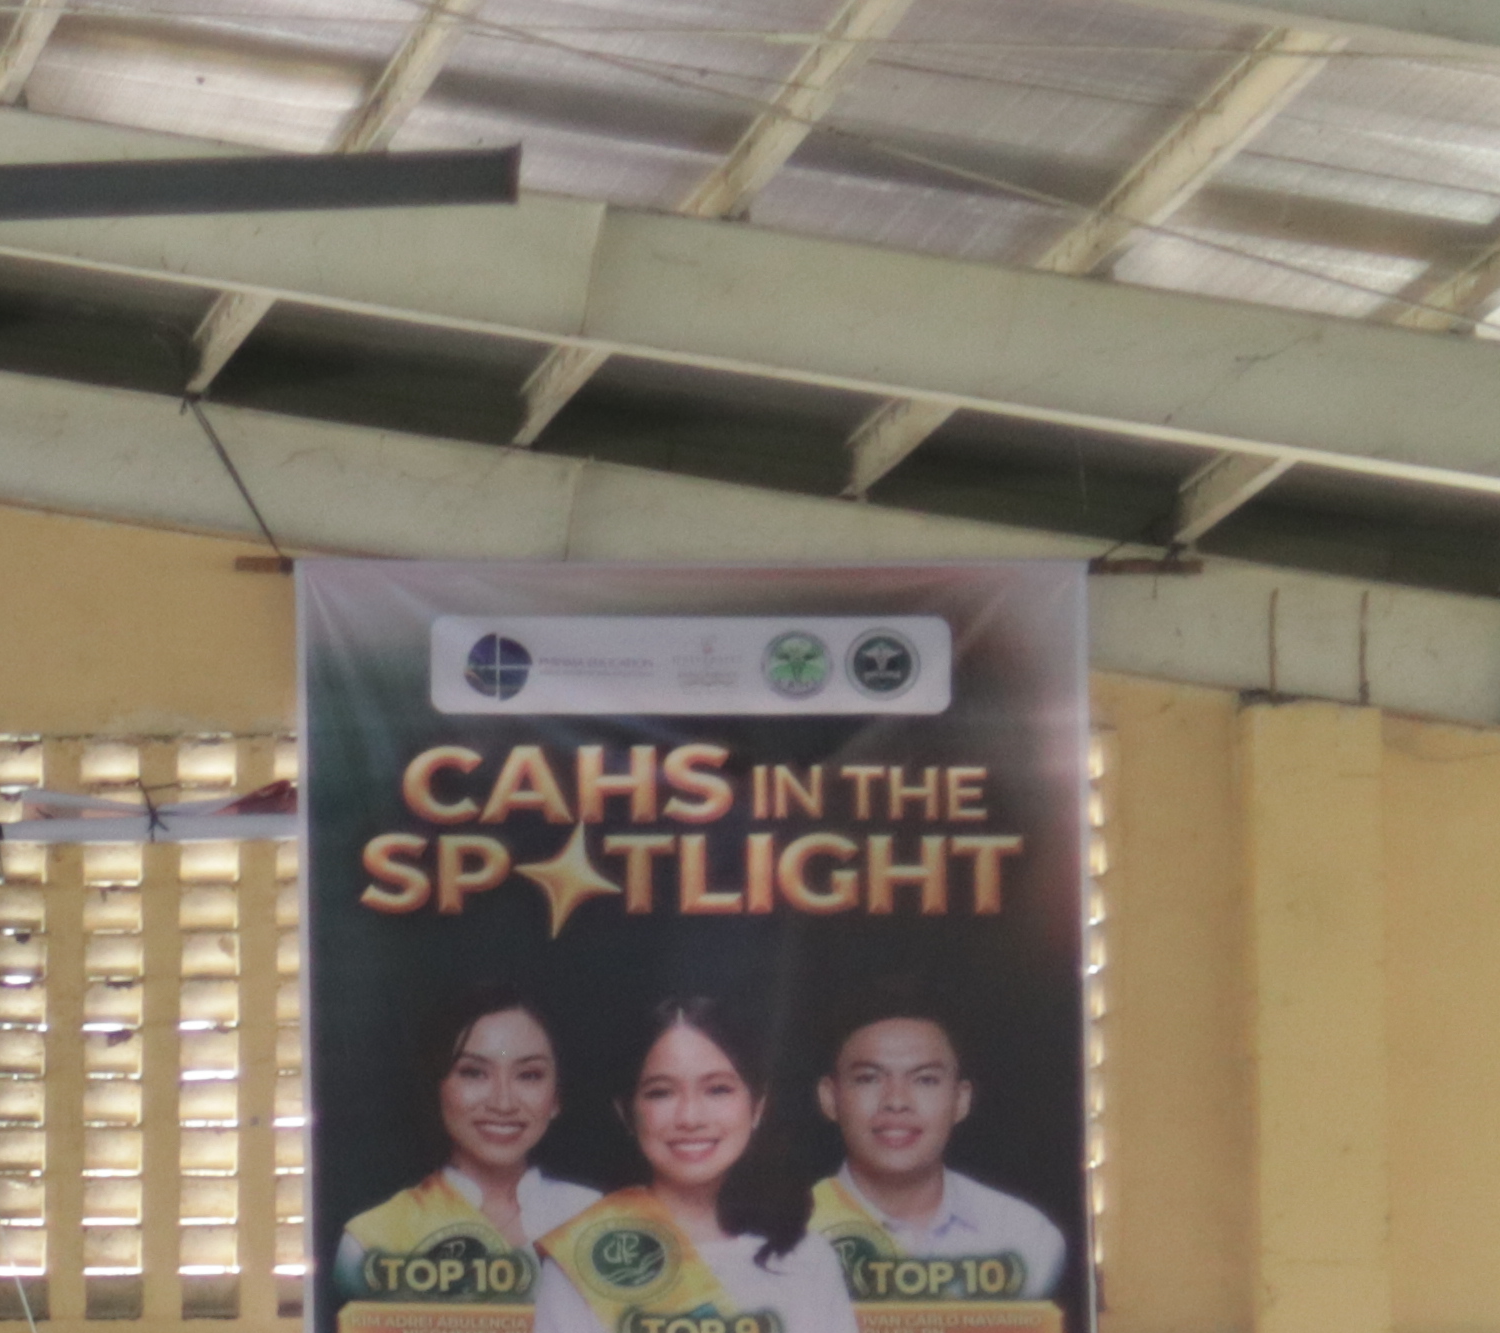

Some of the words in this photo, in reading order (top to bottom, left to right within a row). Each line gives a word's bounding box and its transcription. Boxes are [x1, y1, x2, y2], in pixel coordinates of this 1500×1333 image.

[402, 746, 730, 822] CAHS
[753, 764, 822, 820] IN
[842, 766, 988, 820] THE
[381, 1259, 467, 1293] TOP
[472, 1259, 515, 1293] 10
[870, 1260, 957, 1294] TOP
[963, 1260, 1006, 1294] 10
